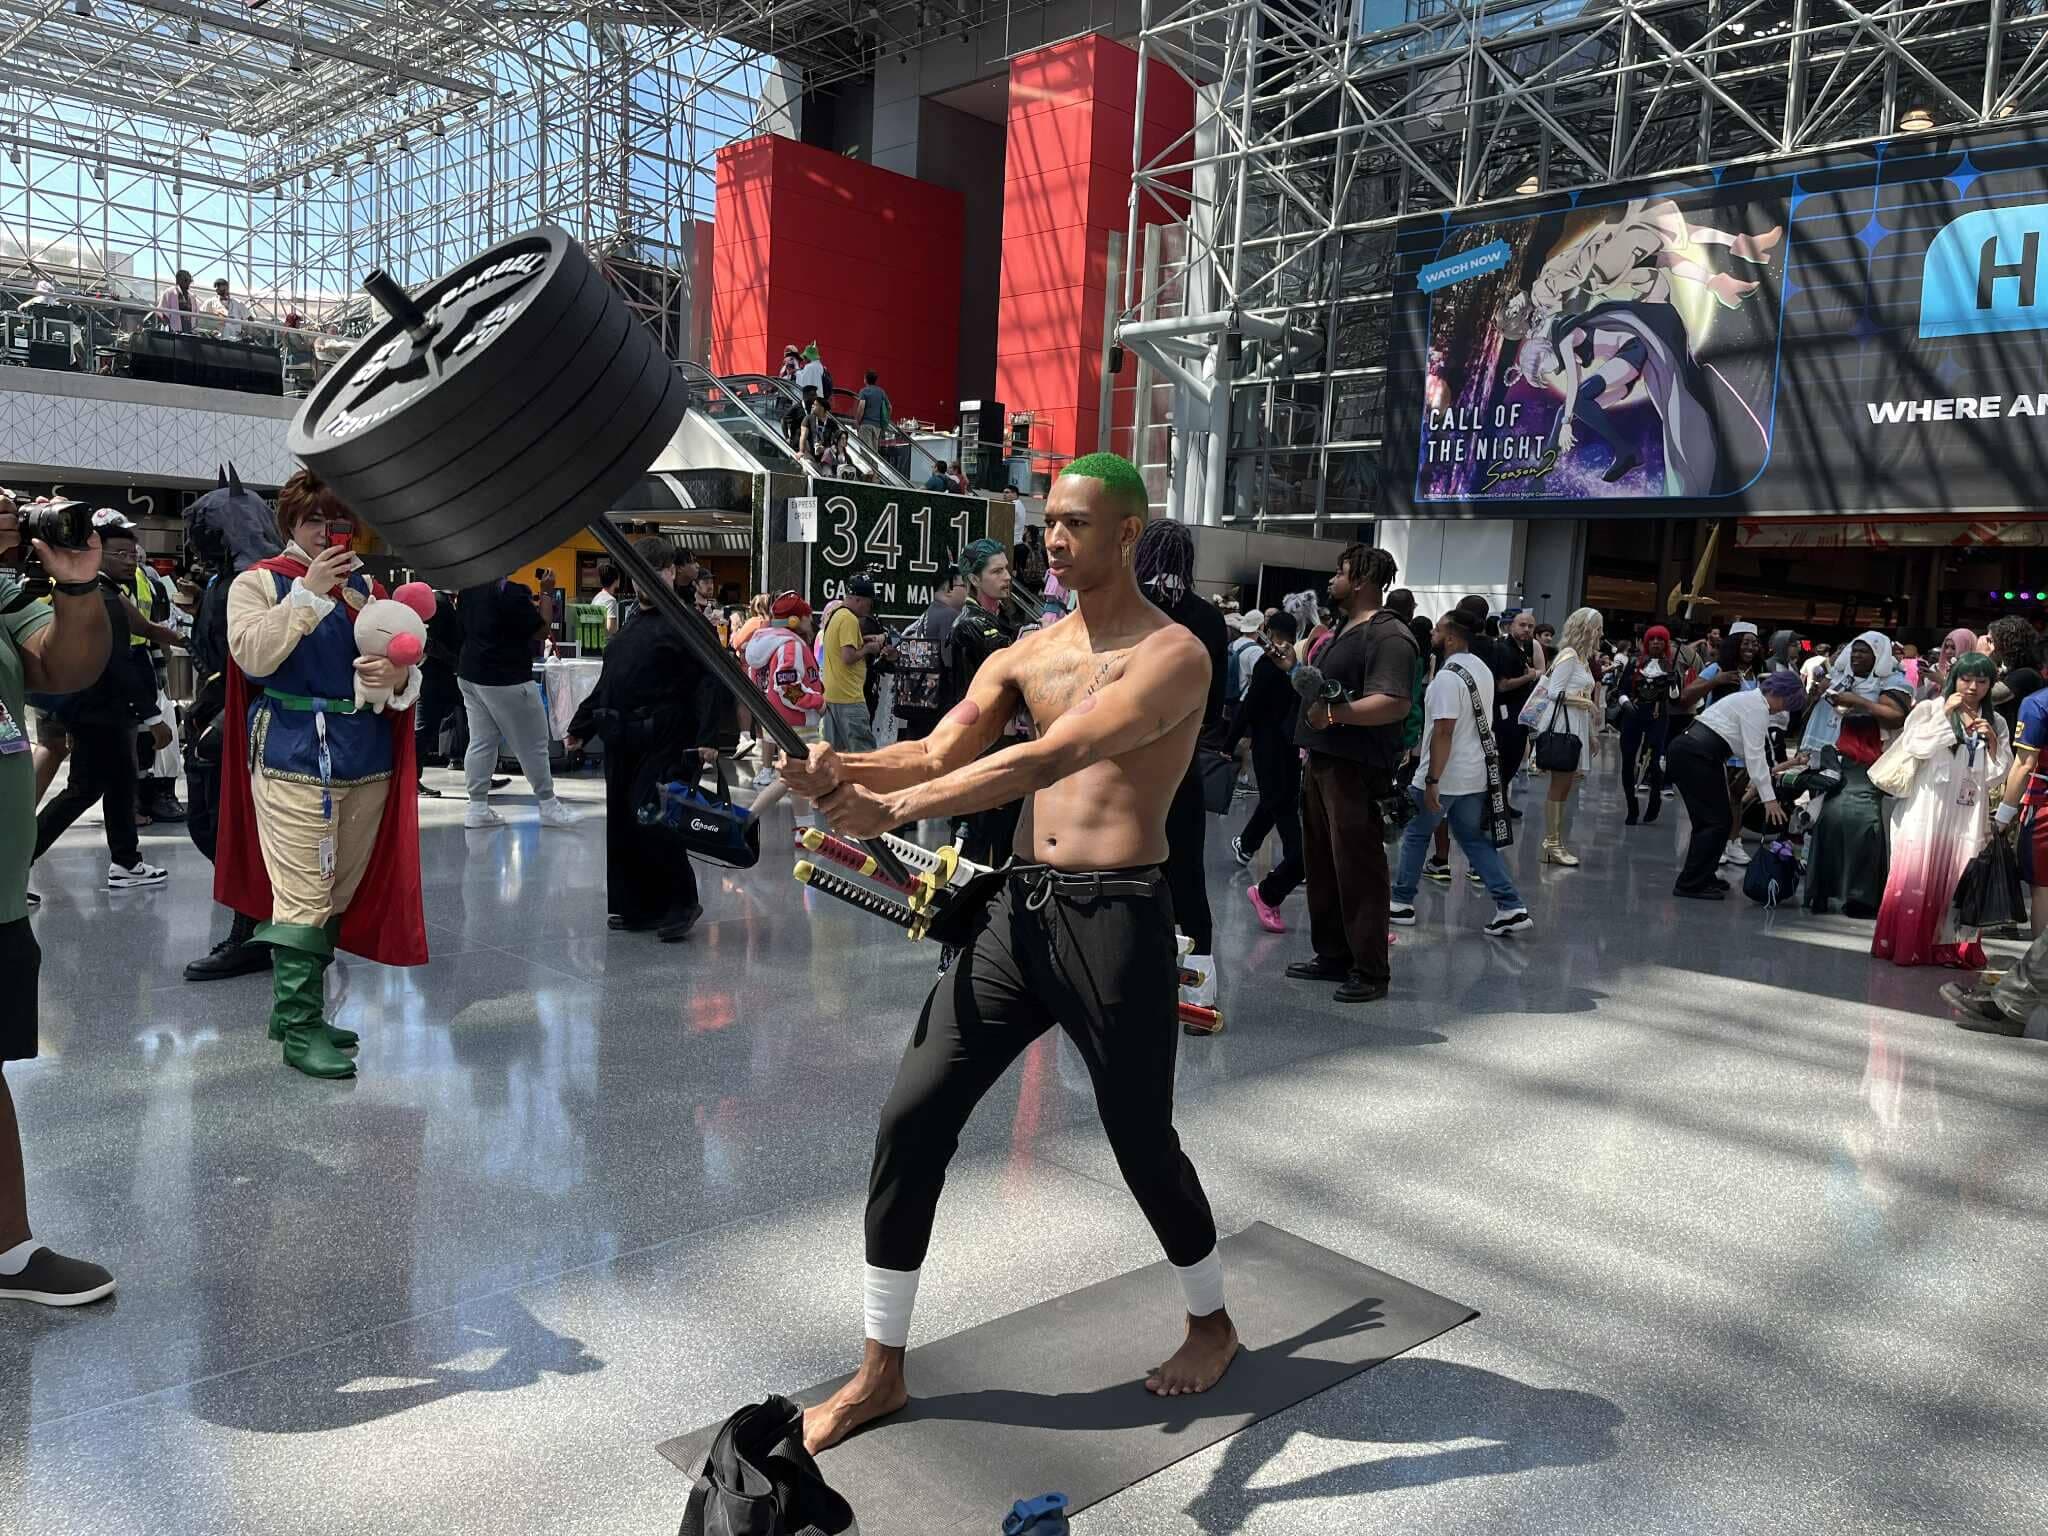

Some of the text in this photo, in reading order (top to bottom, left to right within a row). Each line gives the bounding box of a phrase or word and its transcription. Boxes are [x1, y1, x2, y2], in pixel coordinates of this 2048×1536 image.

[440, 253, 544, 306] BARBELL
[1425, 250, 1502, 283] WATCH NOW
[1429, 403, 1521, 431] CALL OF
[1867, 395, 2001, 424] WHERE
[1428, 436, 1545, 463] THE NIGHT
